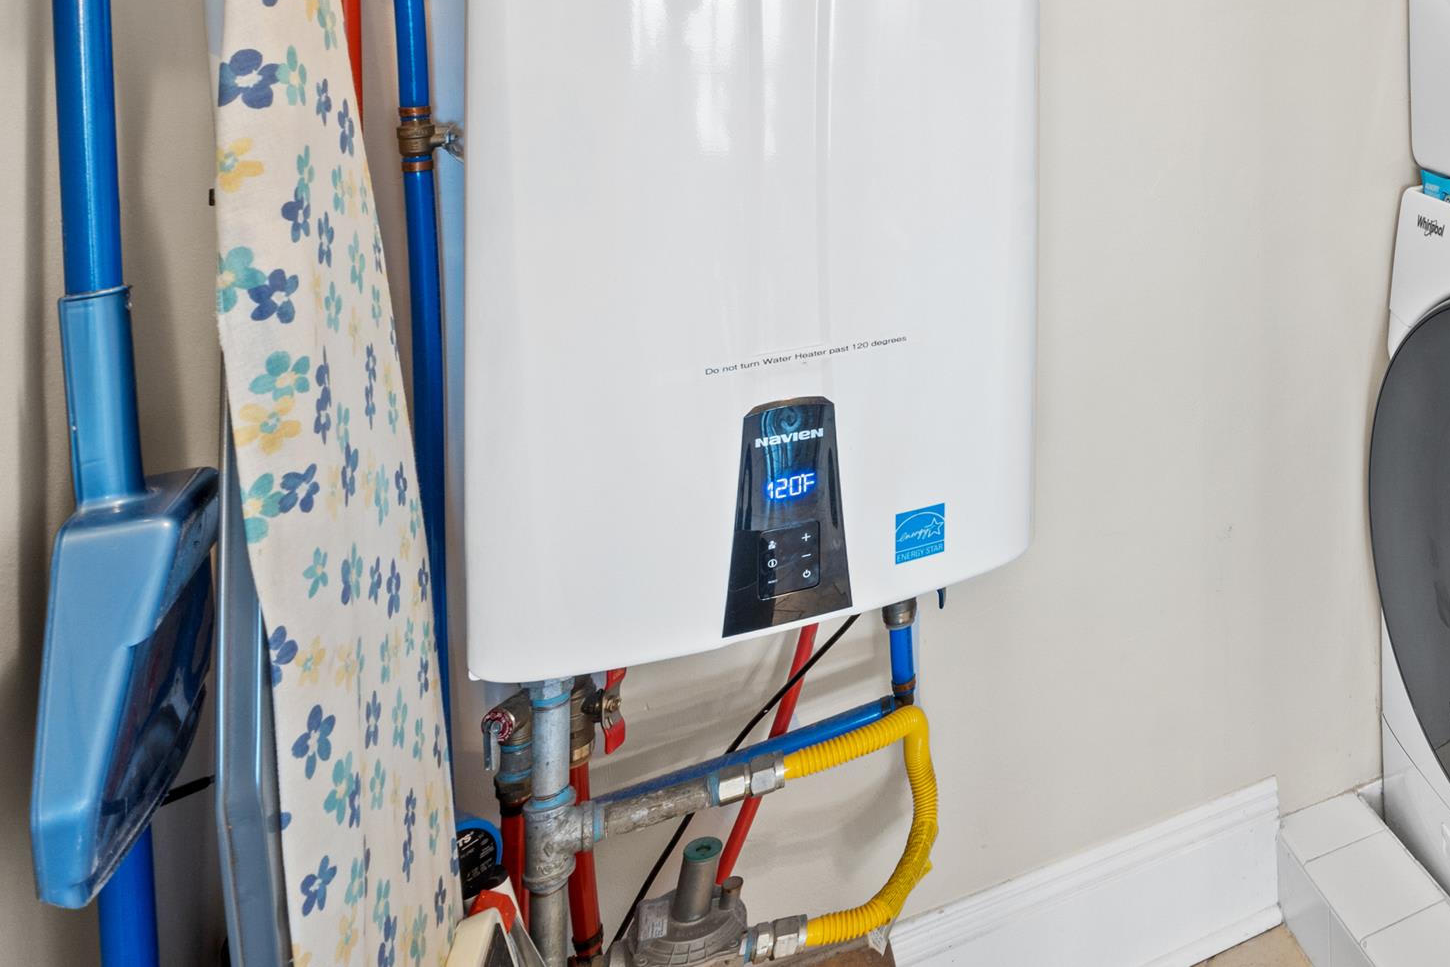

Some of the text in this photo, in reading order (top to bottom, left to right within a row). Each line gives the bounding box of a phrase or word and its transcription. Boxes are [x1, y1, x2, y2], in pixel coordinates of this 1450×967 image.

[1417, 214, 1445, 237] Whirlpool
[704, 335, 908, 376] Do not turn Water Heater past 120 degrees
[896, 543, 944, 563] ENERGY STAR
